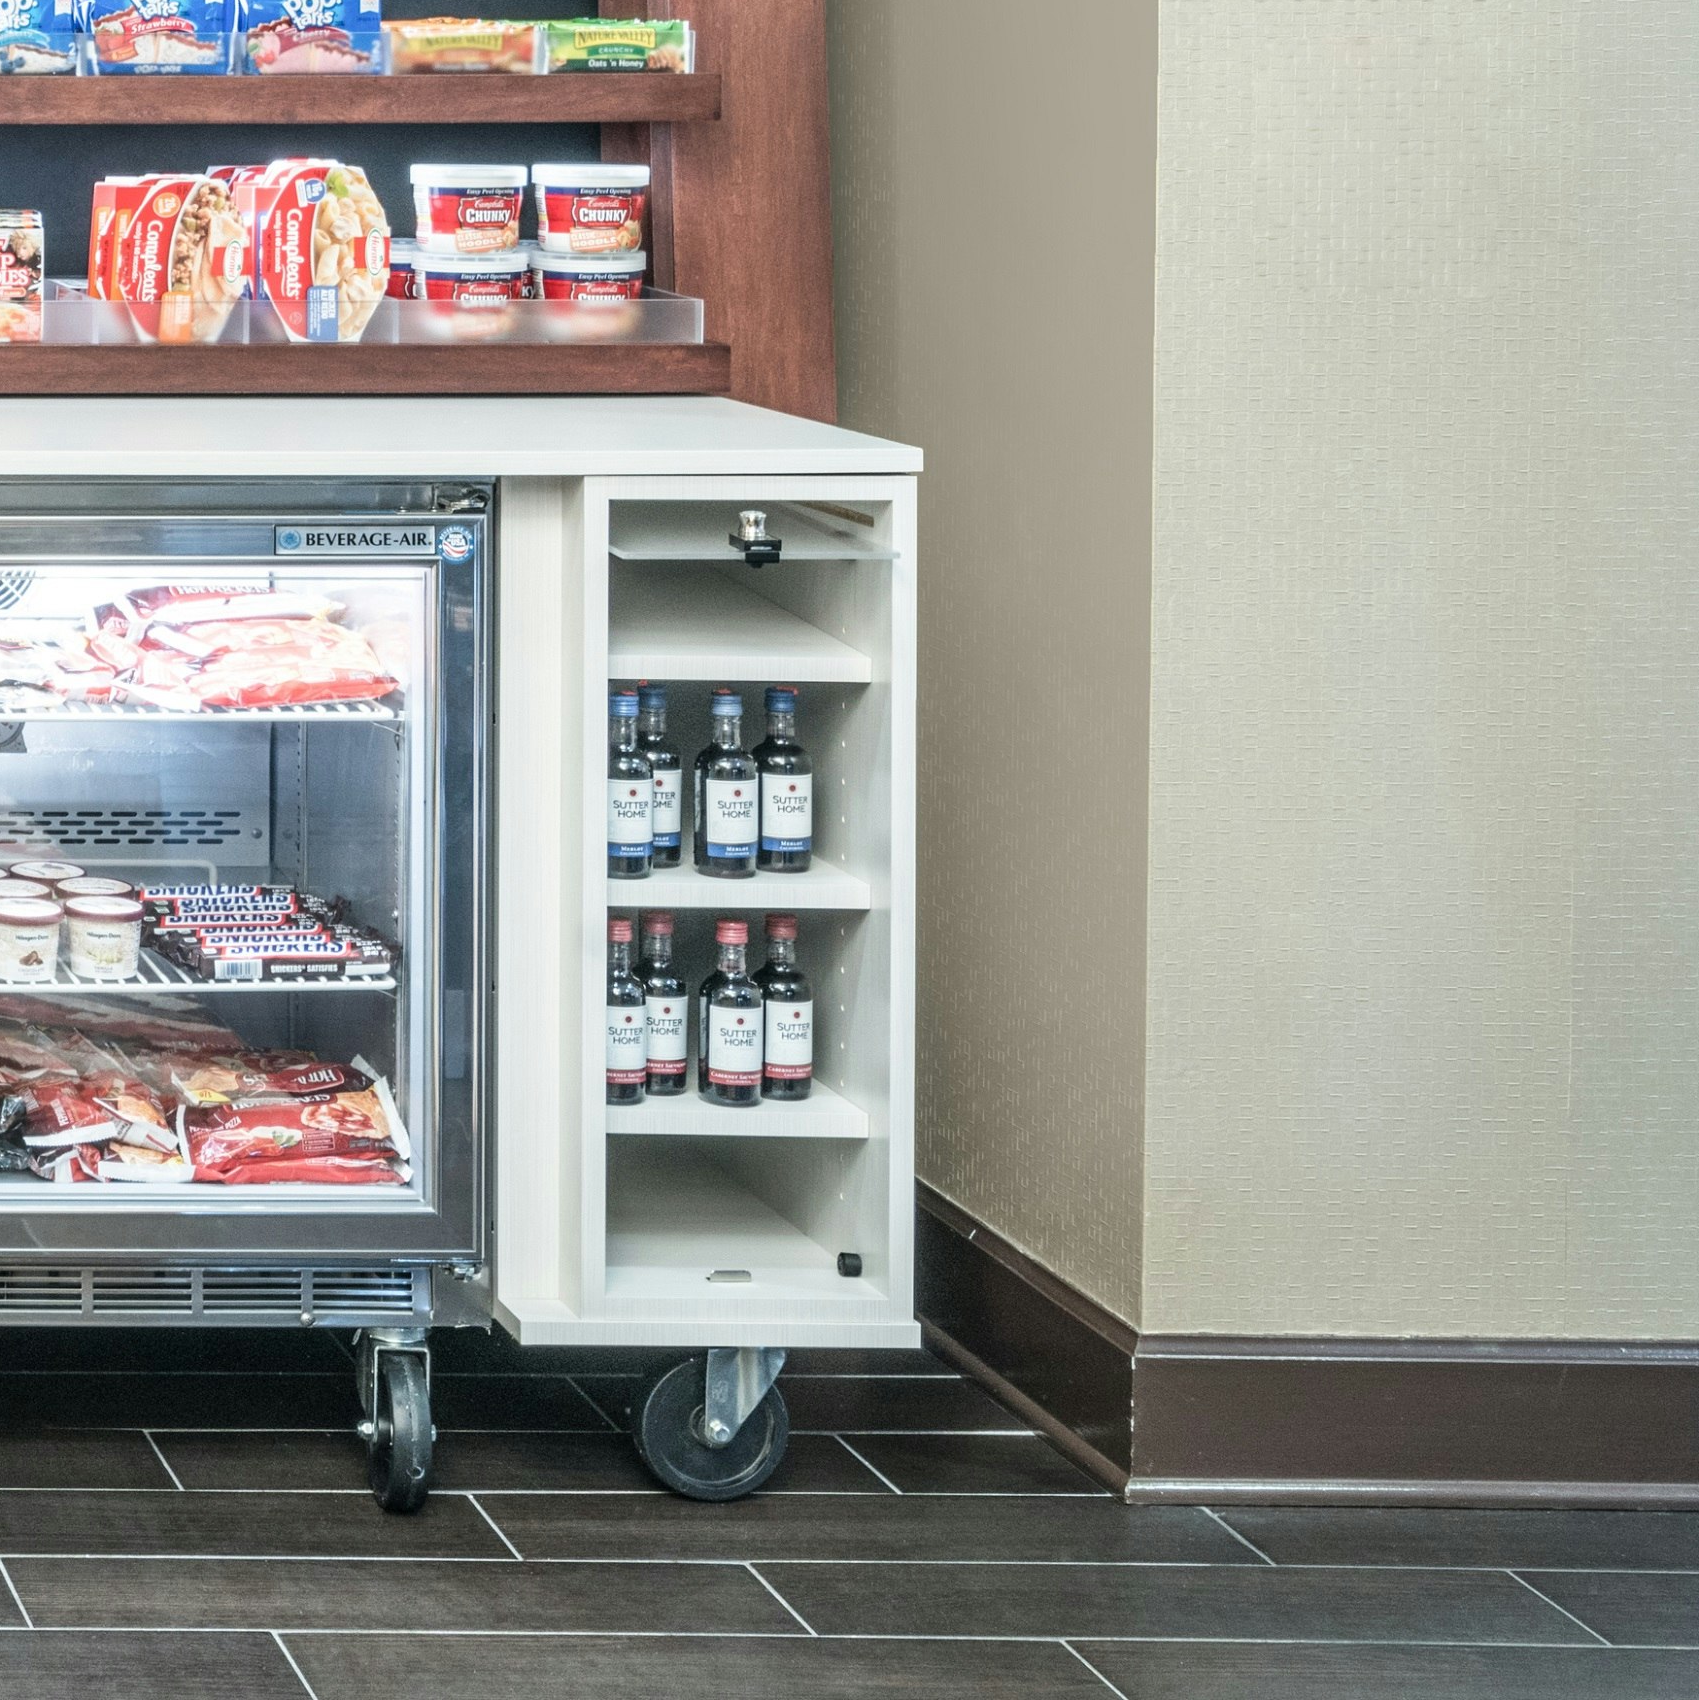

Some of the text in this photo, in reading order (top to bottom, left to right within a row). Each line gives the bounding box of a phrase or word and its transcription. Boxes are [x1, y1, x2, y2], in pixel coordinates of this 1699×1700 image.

[130, 19, 188, 35] Strawberry
[292, 29, 332, 43] Cherry
[577, 29, 654, 47] NATURE VALLEY
[588, 58, 644, 70] Oats Honey
[465, 207, 512, 224] CHUNKY
[579, 207, 629, 224] CHUNKY
[282, 208, 304, 298] Compleats
[140, 219, 164, 302] Compleats
[306, 532, 428, 547] BEVERAGE-AIR
[613, 799, 649, 810] SUTTER
[717, 799, 754, 810] SUTTER
[772, 795, 808, 805] SUTTER
[617, 808, 647, 819] HOME
[722, 809, 752, 819] HOME
[777, 804, 806, 814] HOME
[646, 1016, 683, 1027] SUTTER
[608, 1026, 644, 1036] SUTTER
[650, 1026, 680, 1036] HOME
[719, 1027, 757, 1038] SUTTER
[612, 1035, 641, 1045] HOME
[724, 1037, 754, 1047] HOME
